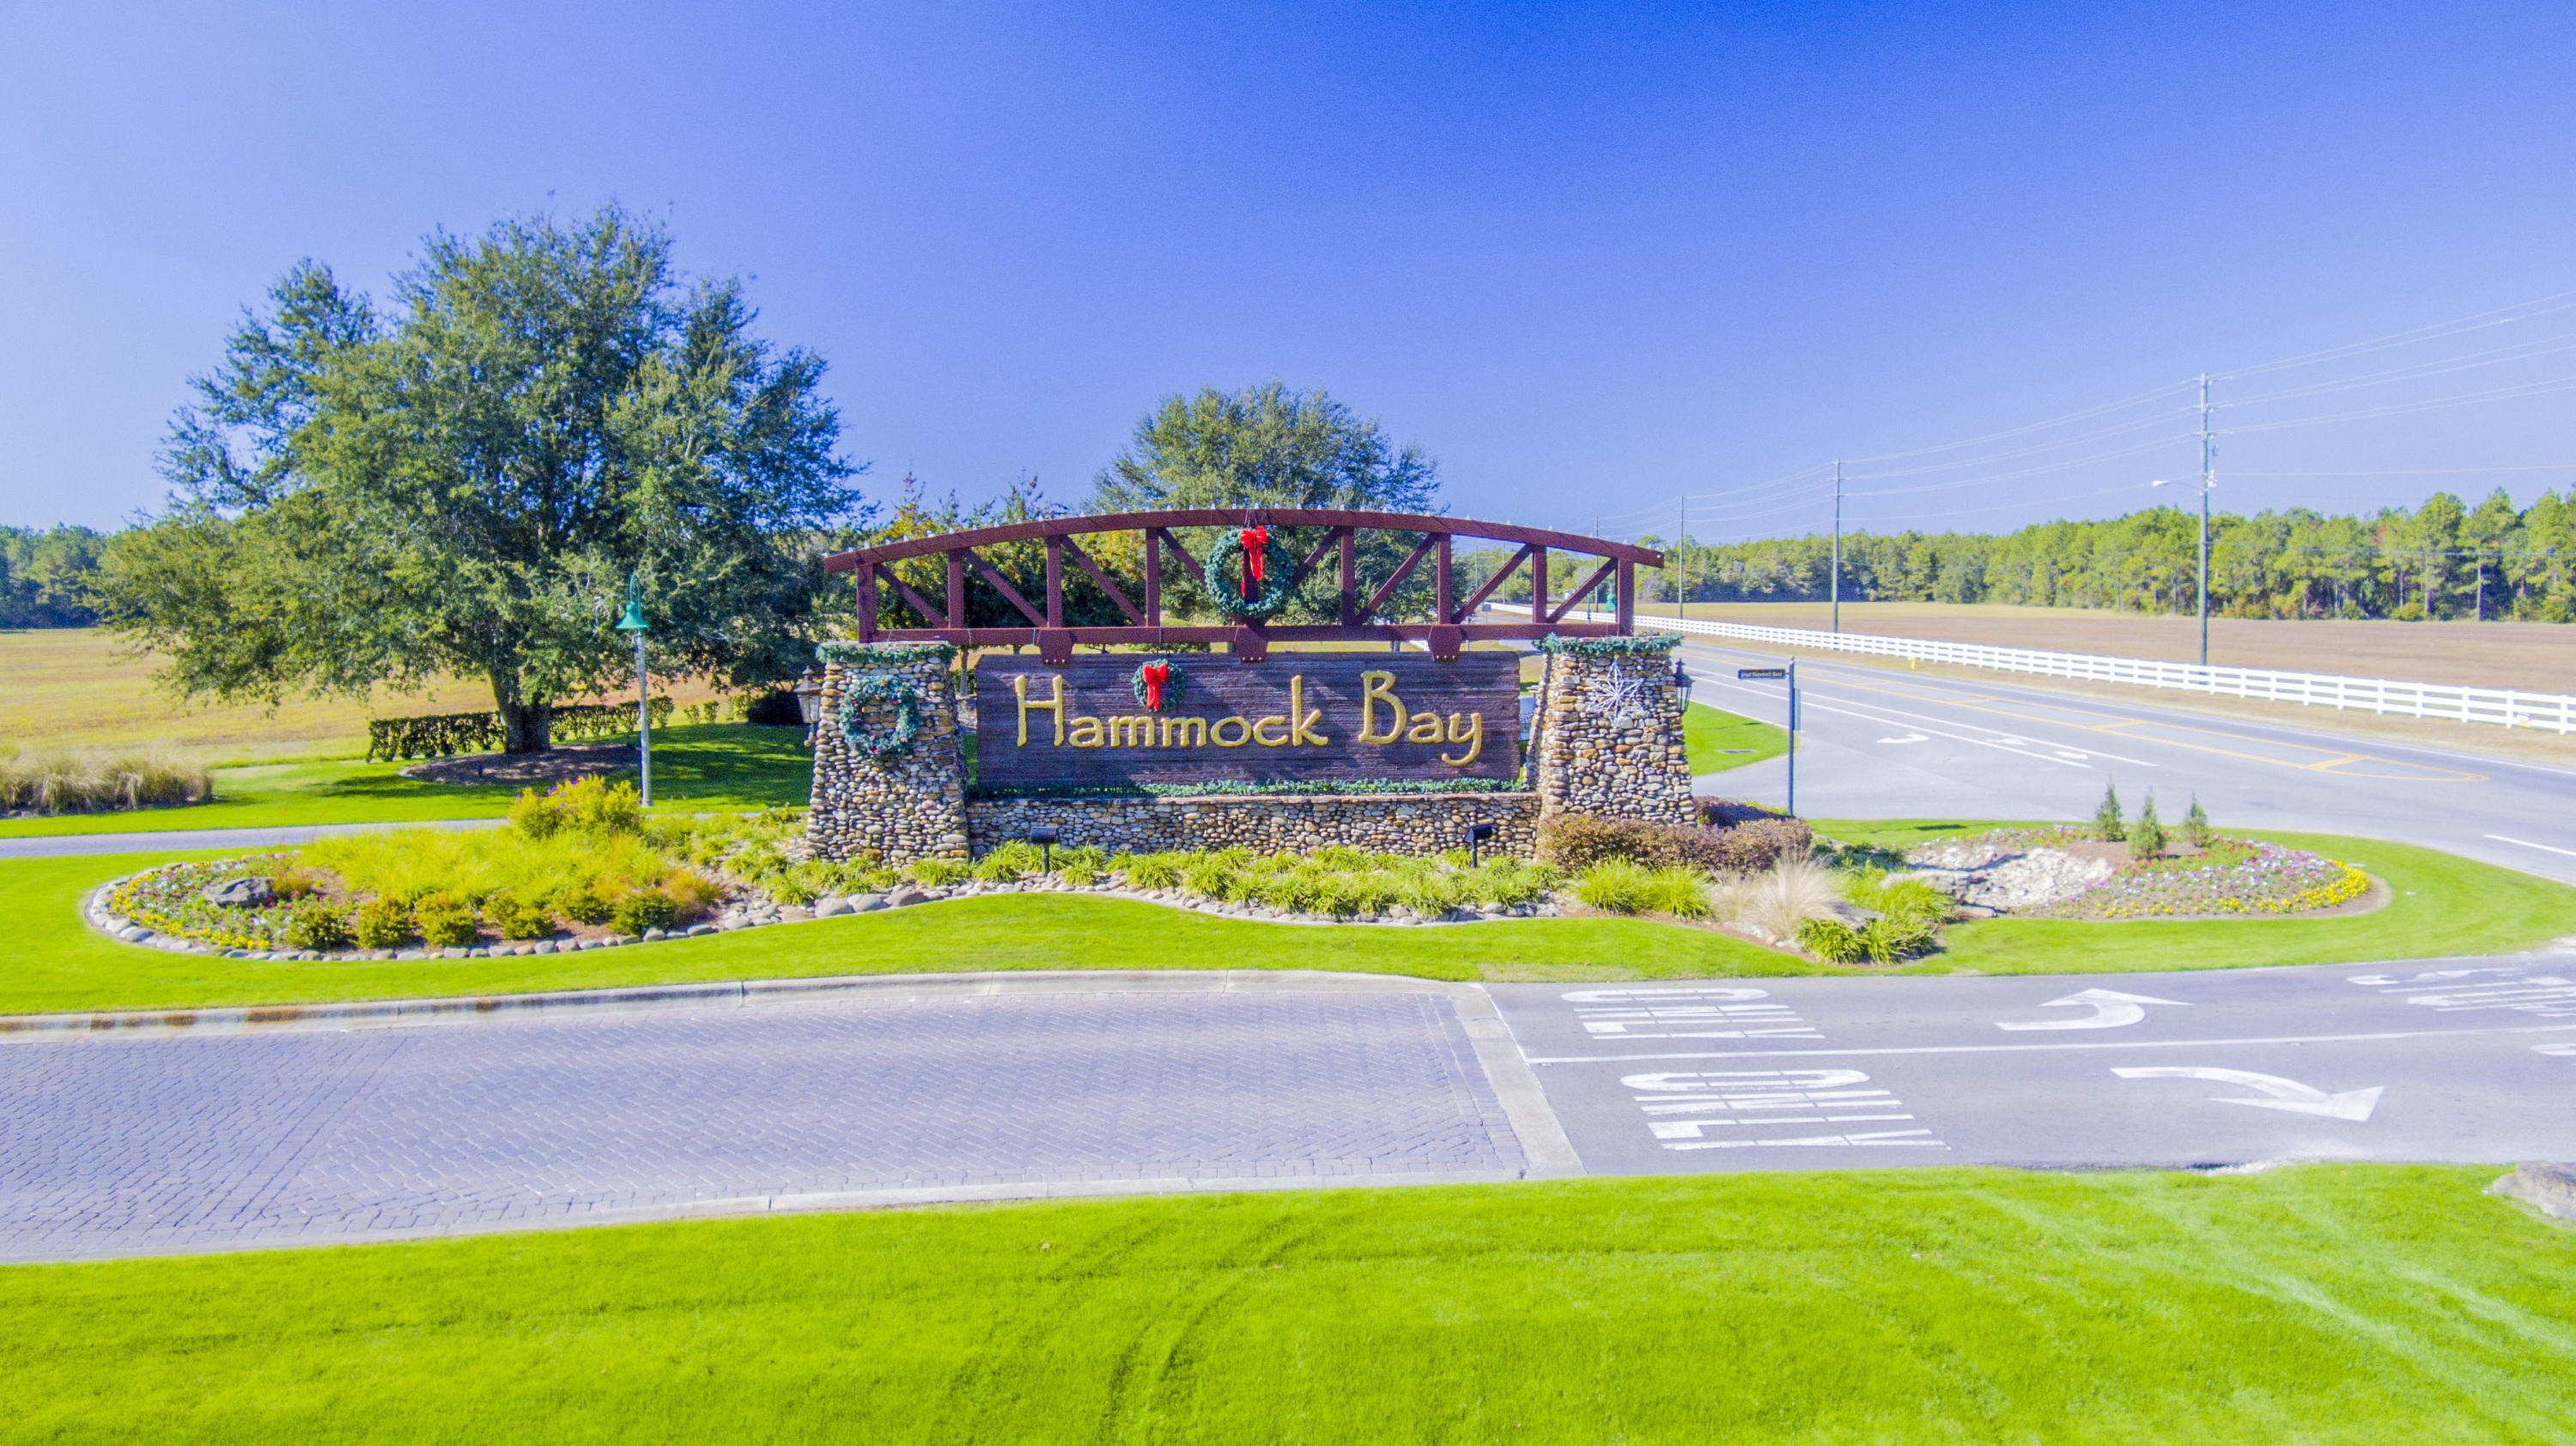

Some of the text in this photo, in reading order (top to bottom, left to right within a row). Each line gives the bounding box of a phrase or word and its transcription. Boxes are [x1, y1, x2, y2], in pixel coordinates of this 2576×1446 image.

[1014, 670, 1483, 767] Hammock Bay
[1559, 987, 1826, 1040] ONLY
[1619, 1068, 1952, 1151] ONLY
